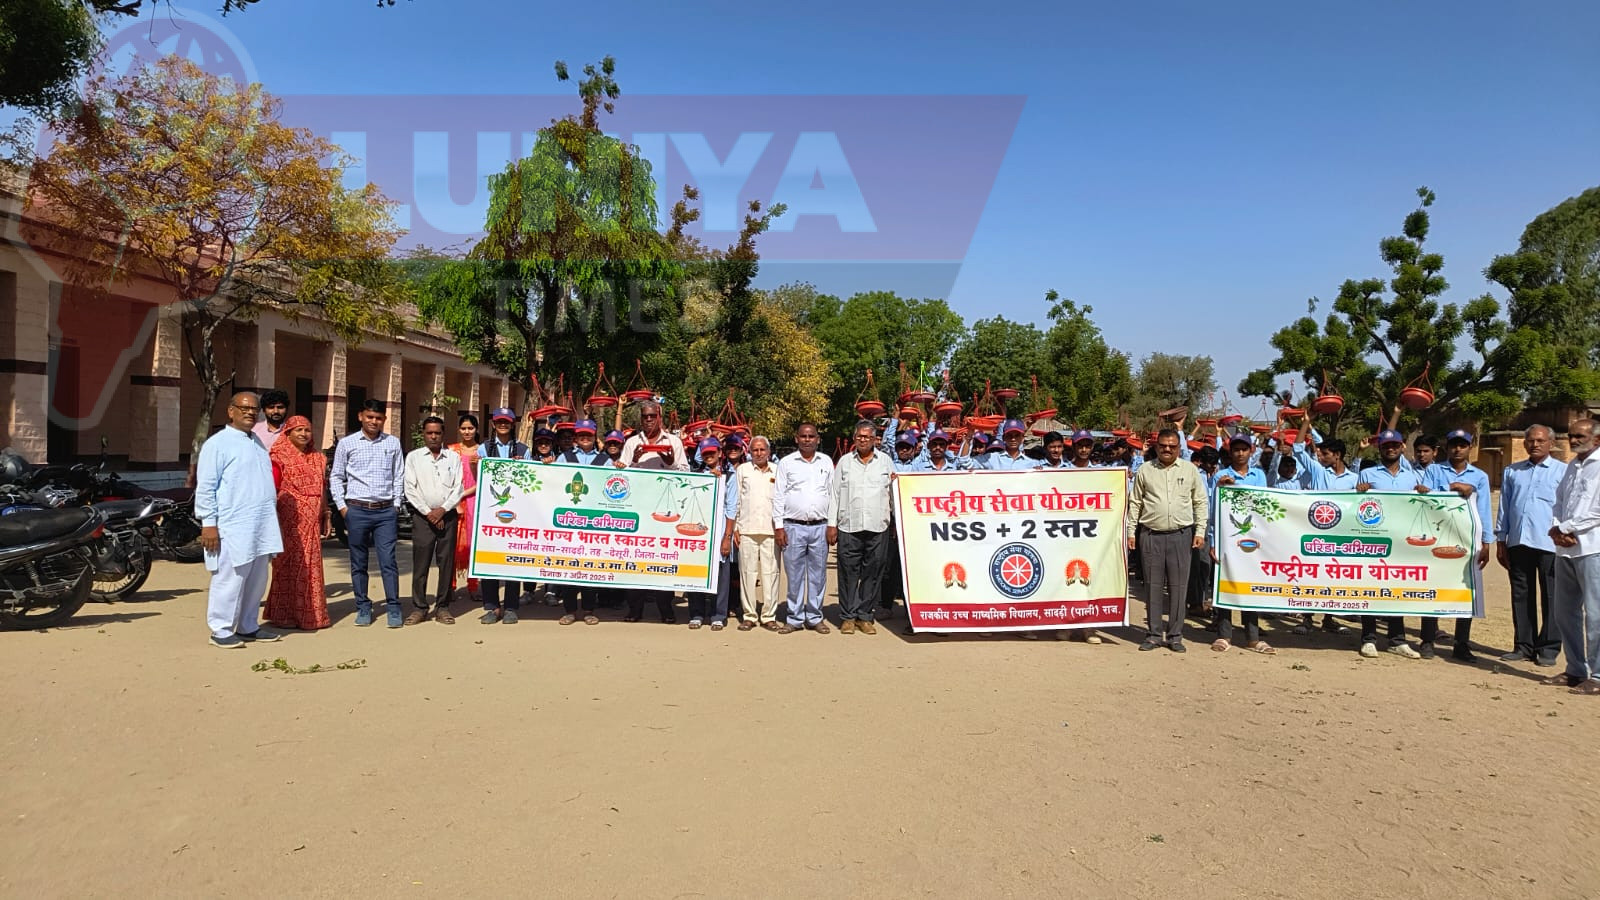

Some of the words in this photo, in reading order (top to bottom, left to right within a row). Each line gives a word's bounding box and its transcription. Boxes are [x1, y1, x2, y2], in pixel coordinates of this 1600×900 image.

[911, 490, 986, 518] राष्ट्रीय
[989, 488, 1036, 512] सेवा
[1038, 486, 1114, 512] योजना
[556, 512, 636, 530] परिंडा-अभियान
[930, 521, 987, 542] NSS
[1021, 519, 1037, 539] 2
[1044, 518, 1099, 539] स्तर
[482, 524, 539, 540] राजस्थान
[543, 527, 573, 543] राज्य
[578, 530, 610, 545] भारत
[612, 533, 656, 549] स्काउट
[660, 537, 671, 550] व
[673, 537, 708, 554] गाइड
[508, 540, 539, 552] स्थानीय
[1304, 538, 1389, 555] परिंडा-अभियान
[506, 555, 535, 564] स्थान
[1261, 555, 1320, 582] राष्ट्रीय
[1325, 557, 1363, 580] सेवा
[1368, 558, 1429, 581] योजना
[1251, 585, 1283, 594] स्थान
[920, 607, 950, 620] राजकीय
[952, 609, 969, 620] उच्च
[972, 607, 1007, 620] माध्यमिक
[1043, 604, 1067, 621] सादड़ी
[1070, 604, 1100, 618] (पाली)
[1102, 602, 1121, 615] राज.
[1342, 602, 1359, 610] 2025
[1361, 600, 1369, 609] से
